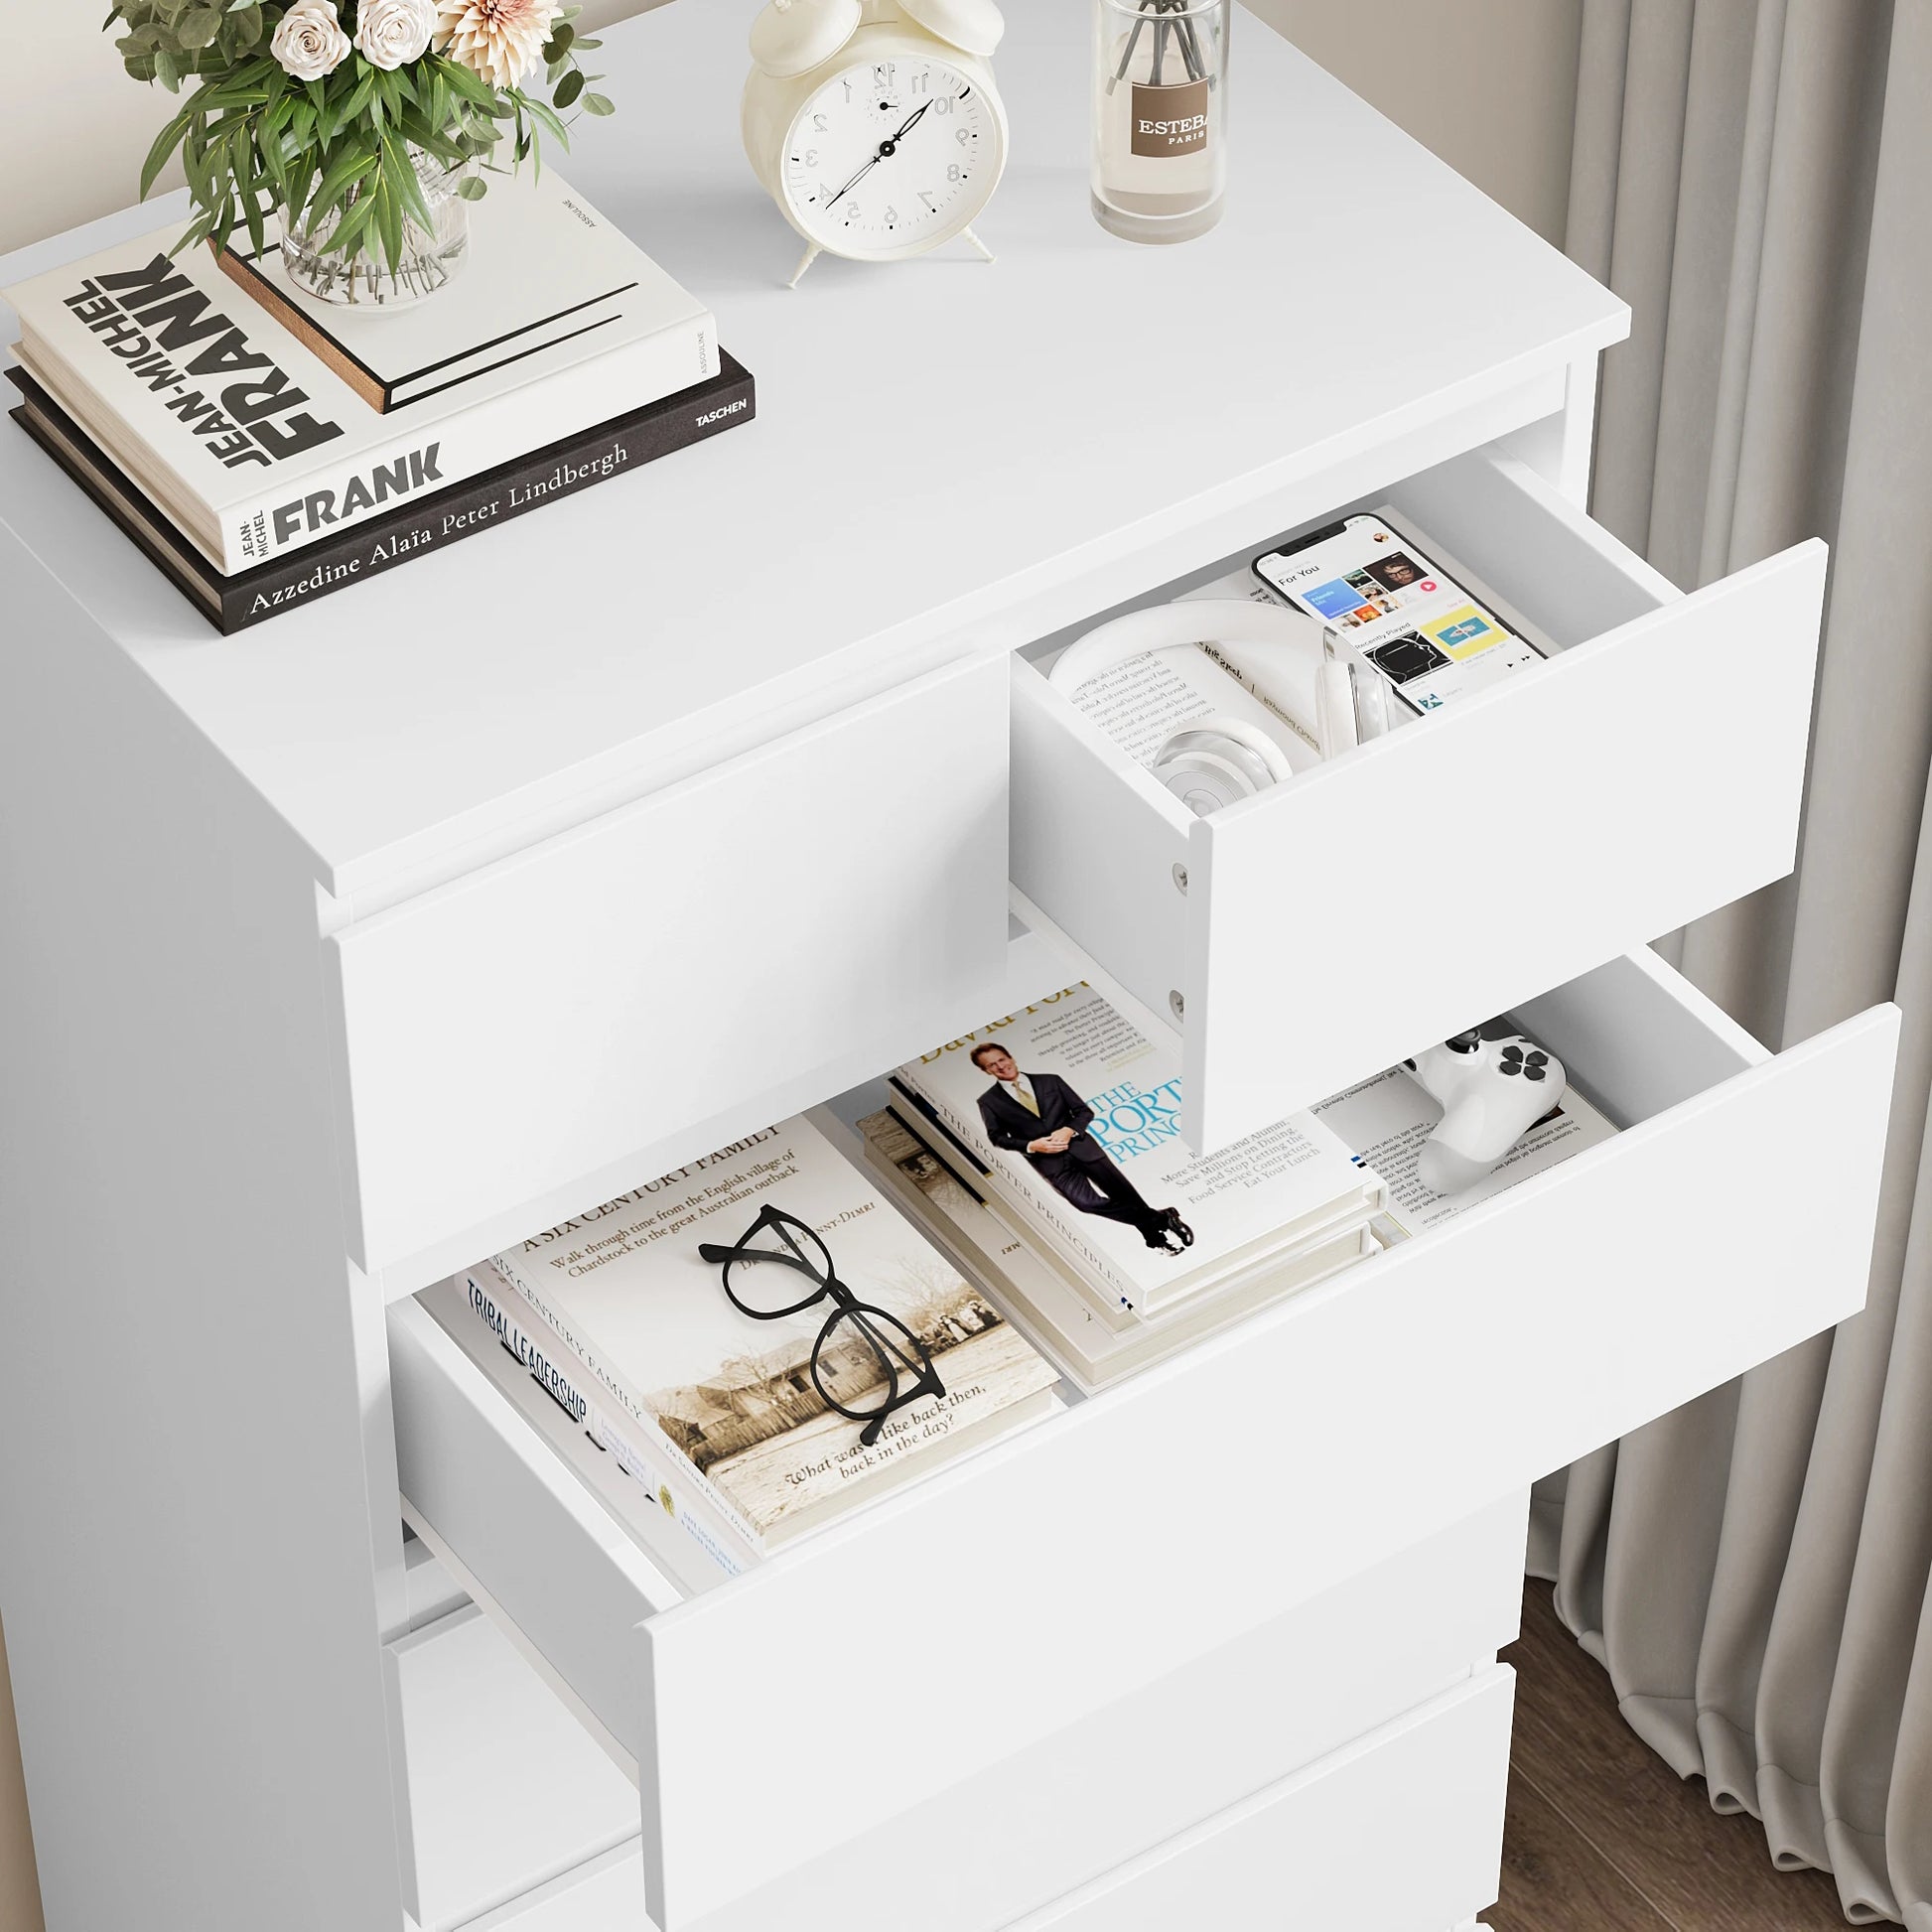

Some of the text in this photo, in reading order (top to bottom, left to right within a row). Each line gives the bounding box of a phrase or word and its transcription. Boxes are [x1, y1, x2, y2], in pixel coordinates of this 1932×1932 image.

[1168, 130, 1204, 145] PARIS
[561, 199, 597, 228] ASSOULINE
[62, 279, 273, 469] JEAN-MICHEL
[93, 252, 345, 461] FRANK
[697, 331, 708, 374] ASSOULINE
[695, 398, 748, 427] TASCHEN
[272, 442, 444, 545] FRANK
[239, 521, 254, 557] JEAN-
[250, 443, 628, 615] Azzedine Alaïa Peter Lindbergh
[252, 509, 269, 557] MICHEL
[1278, 573, 1298, 587] For
[1297, 565, 1320, 577] You
[1354, 621, 1411, 650] Recently Played
[1085, 1078, 1181, 1148] PORT
[1086, 1081, 1142, 1113] THE
[1105, 1112, 1181, 1164] PRINC
[1160, 1169, 1188, 1184] More
[1186, 1148, 1231, 1171] Students
[1231, 1137, 1251, 1152] and
[1204, 1132, 1305, 1186] and Stop Letting the
[1174, 1173, 1204, 1188] Save
[1203, 1153, 1243, 1177] Millions
[1242, 1144, 1260, 1157] on
[1187, 1141, 1313, 1204] Food Service Contractors
[1242, 1147, 1321, 1189] Eat Your Lunch
[549, 1148, 795, 1270] Walk through time from the English village of
[568, 1166, 800, 1278] Chardstock to the great Australian outback
[800, 1201, 876, 1241] PNNY-DIMRI
[940, 1104, 971, 1141] THE
[974, 1139, 1033, 1201] PORTER
[1036, 1199, 1125, 1292] PRINCIPLES
[522, 1239, 541, 1253] A
[540, 1221, 582, 1243] SIX
[468, 1279, 511, 1348] TRIBAL
[513, 1328, 588, 1424] LEADERSHIP
[516, 1280, 586, 1356] CENTURY
[587, 1356, 642, 1420] FAMILY
[785, 1384, 988, 1485] What was like back then,
[839, 1413, 955, 1479] back in the day?
